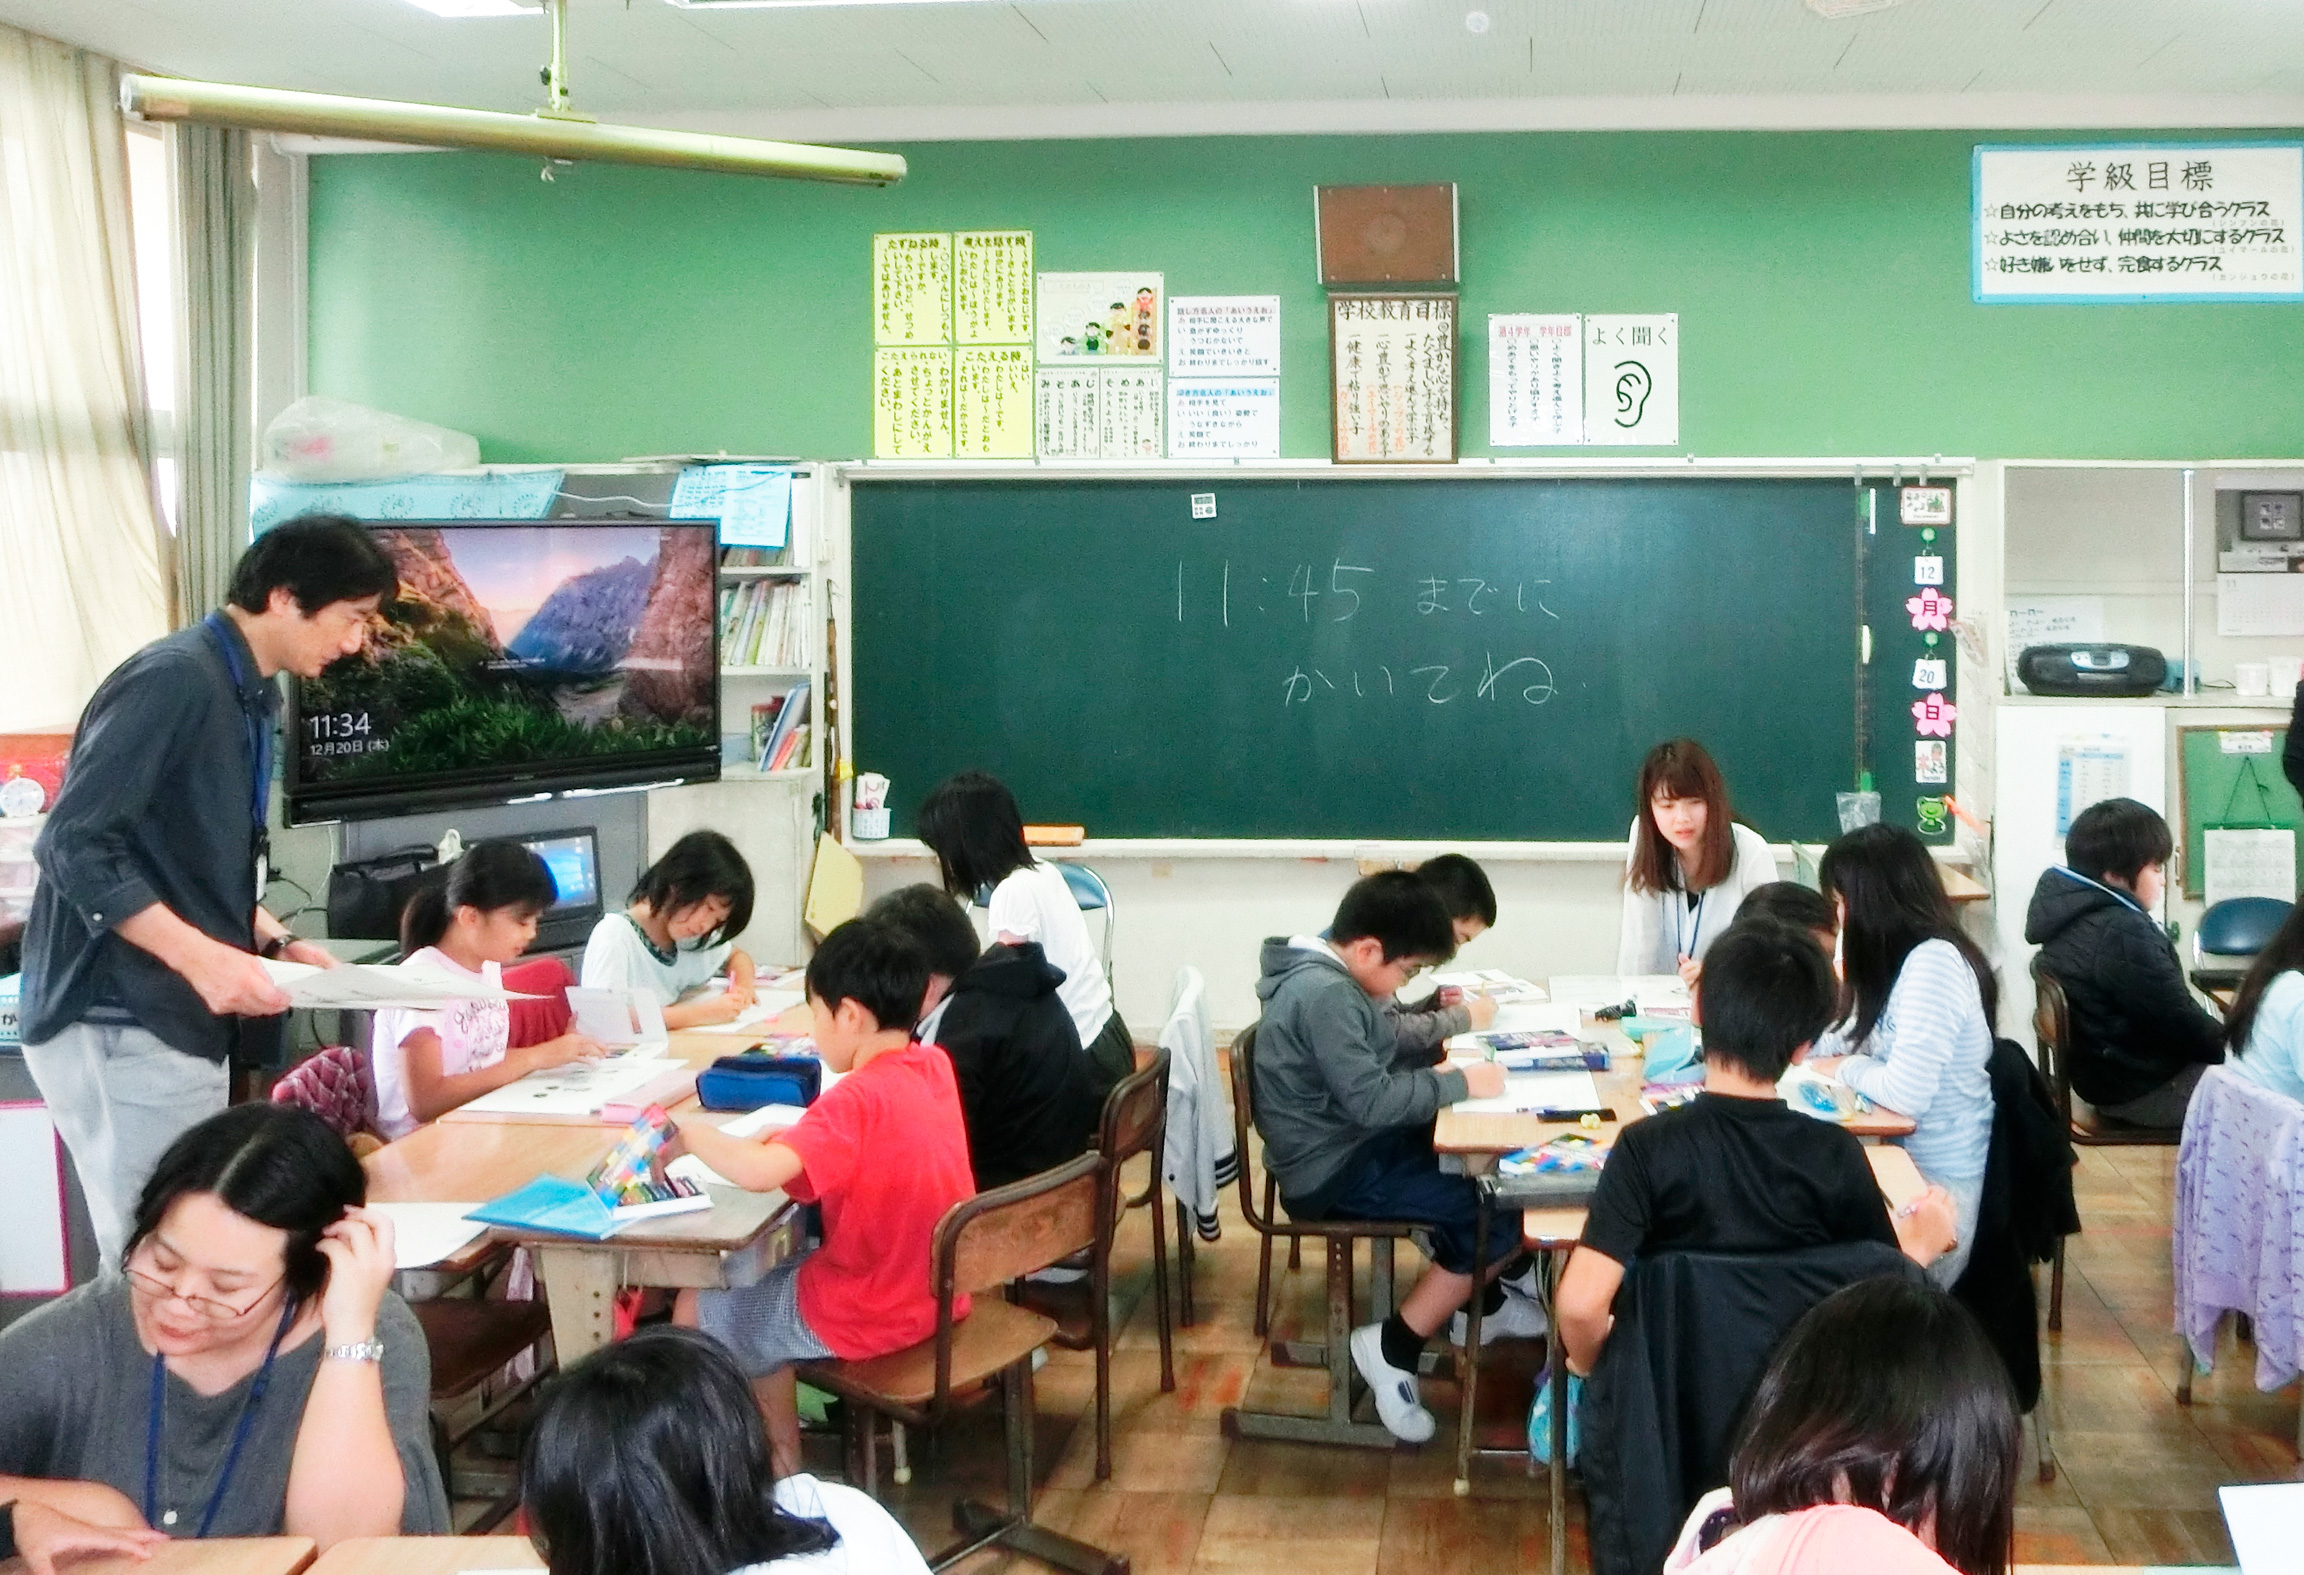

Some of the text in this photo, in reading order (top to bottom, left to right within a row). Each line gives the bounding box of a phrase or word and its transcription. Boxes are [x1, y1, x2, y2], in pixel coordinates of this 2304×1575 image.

[2066, 161, 2214, 192] 学級目標
[888, 238, 939, 249] たずねる時
[1338, 300, 1451, 320] 学校教育目標
[1593, 326, 1668, 346] よく聞く
[965, 351, 1021, 362] こたえる時
[1921, 566, 1935, 579] 12
[1177, 556, 1560, 627] 11:45 までに
[1922, 601, 1938, 616] 月
[1282, 651, 1558, 707] かいてね
[1919, 669, 1935, 683] 20
[1926, 705, 1940, 720] 日
[309, 711, 372, 739] 11:34
[310, 740, 363, 756] 12月20日
